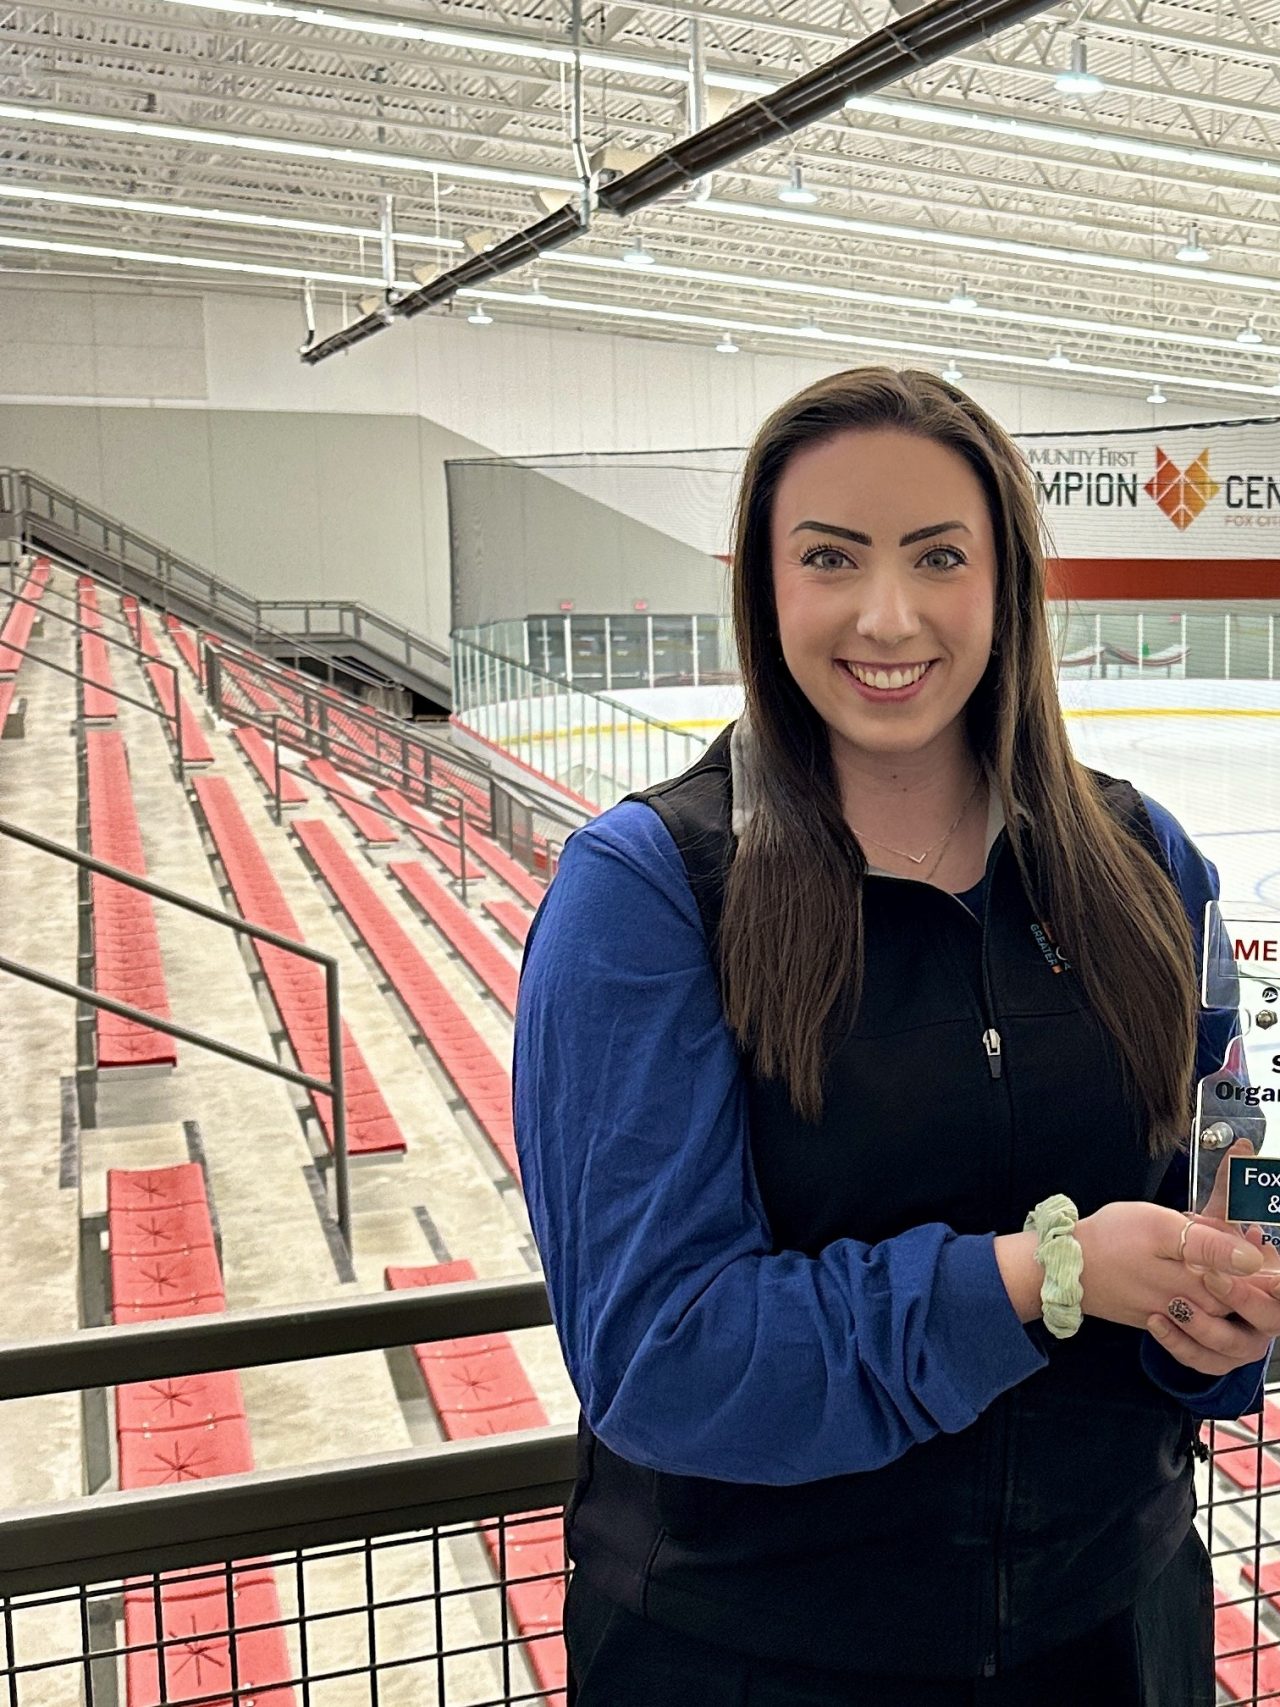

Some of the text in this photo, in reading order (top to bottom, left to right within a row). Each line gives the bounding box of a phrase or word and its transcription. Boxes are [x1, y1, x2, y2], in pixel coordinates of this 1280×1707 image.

[1028, 448, 1095, 465] MUNITY
[1036, 471, 1138, 507] MPION
[1225, 515, 1253, 527] FOX
